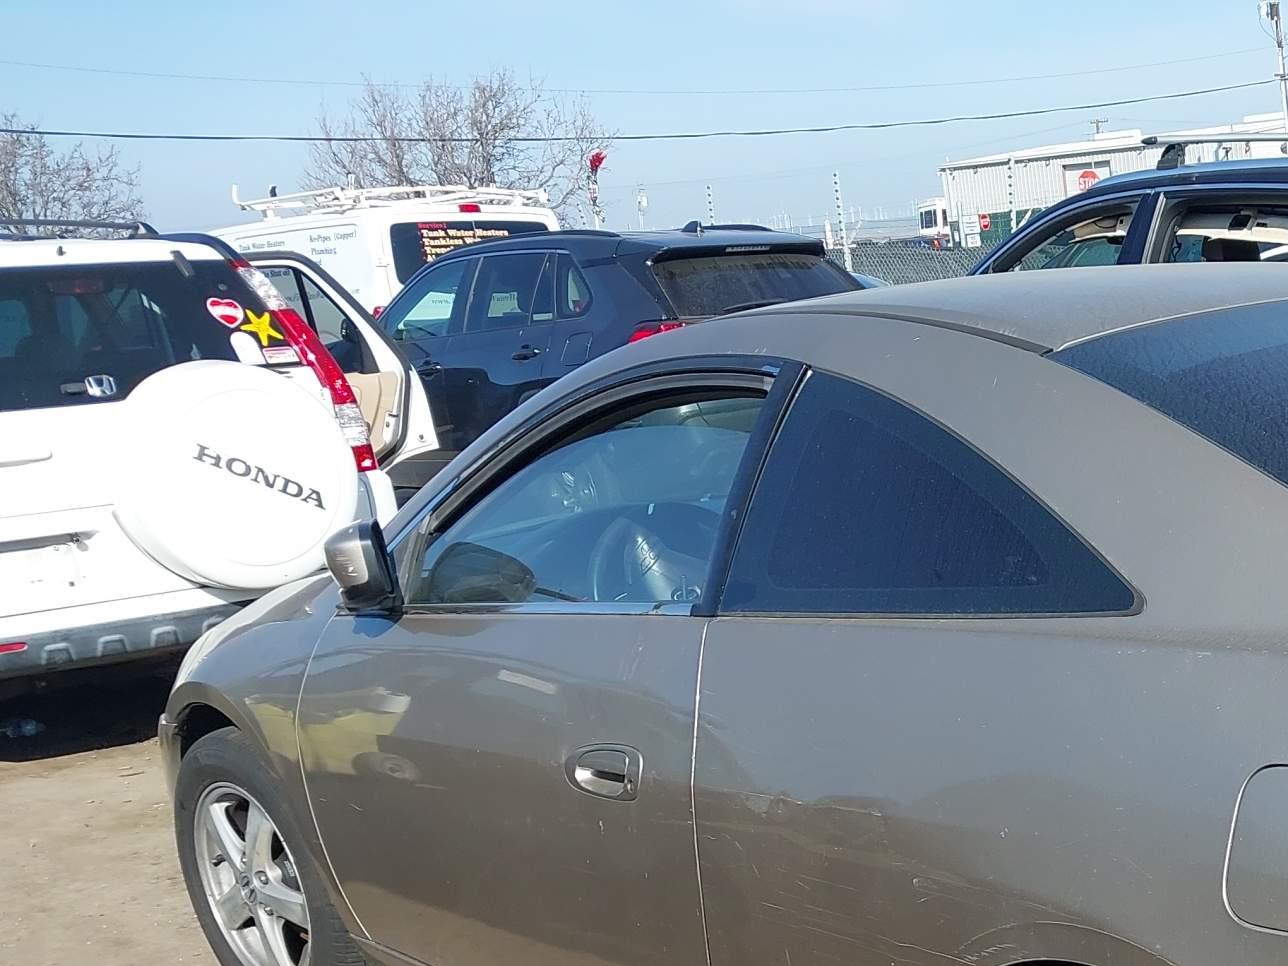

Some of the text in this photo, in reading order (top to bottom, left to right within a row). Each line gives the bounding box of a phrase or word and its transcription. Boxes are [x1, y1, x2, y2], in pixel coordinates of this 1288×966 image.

[421, 228, 510, 237] Tank Water Heaters
[193, 443, 327, 511] HONDA
